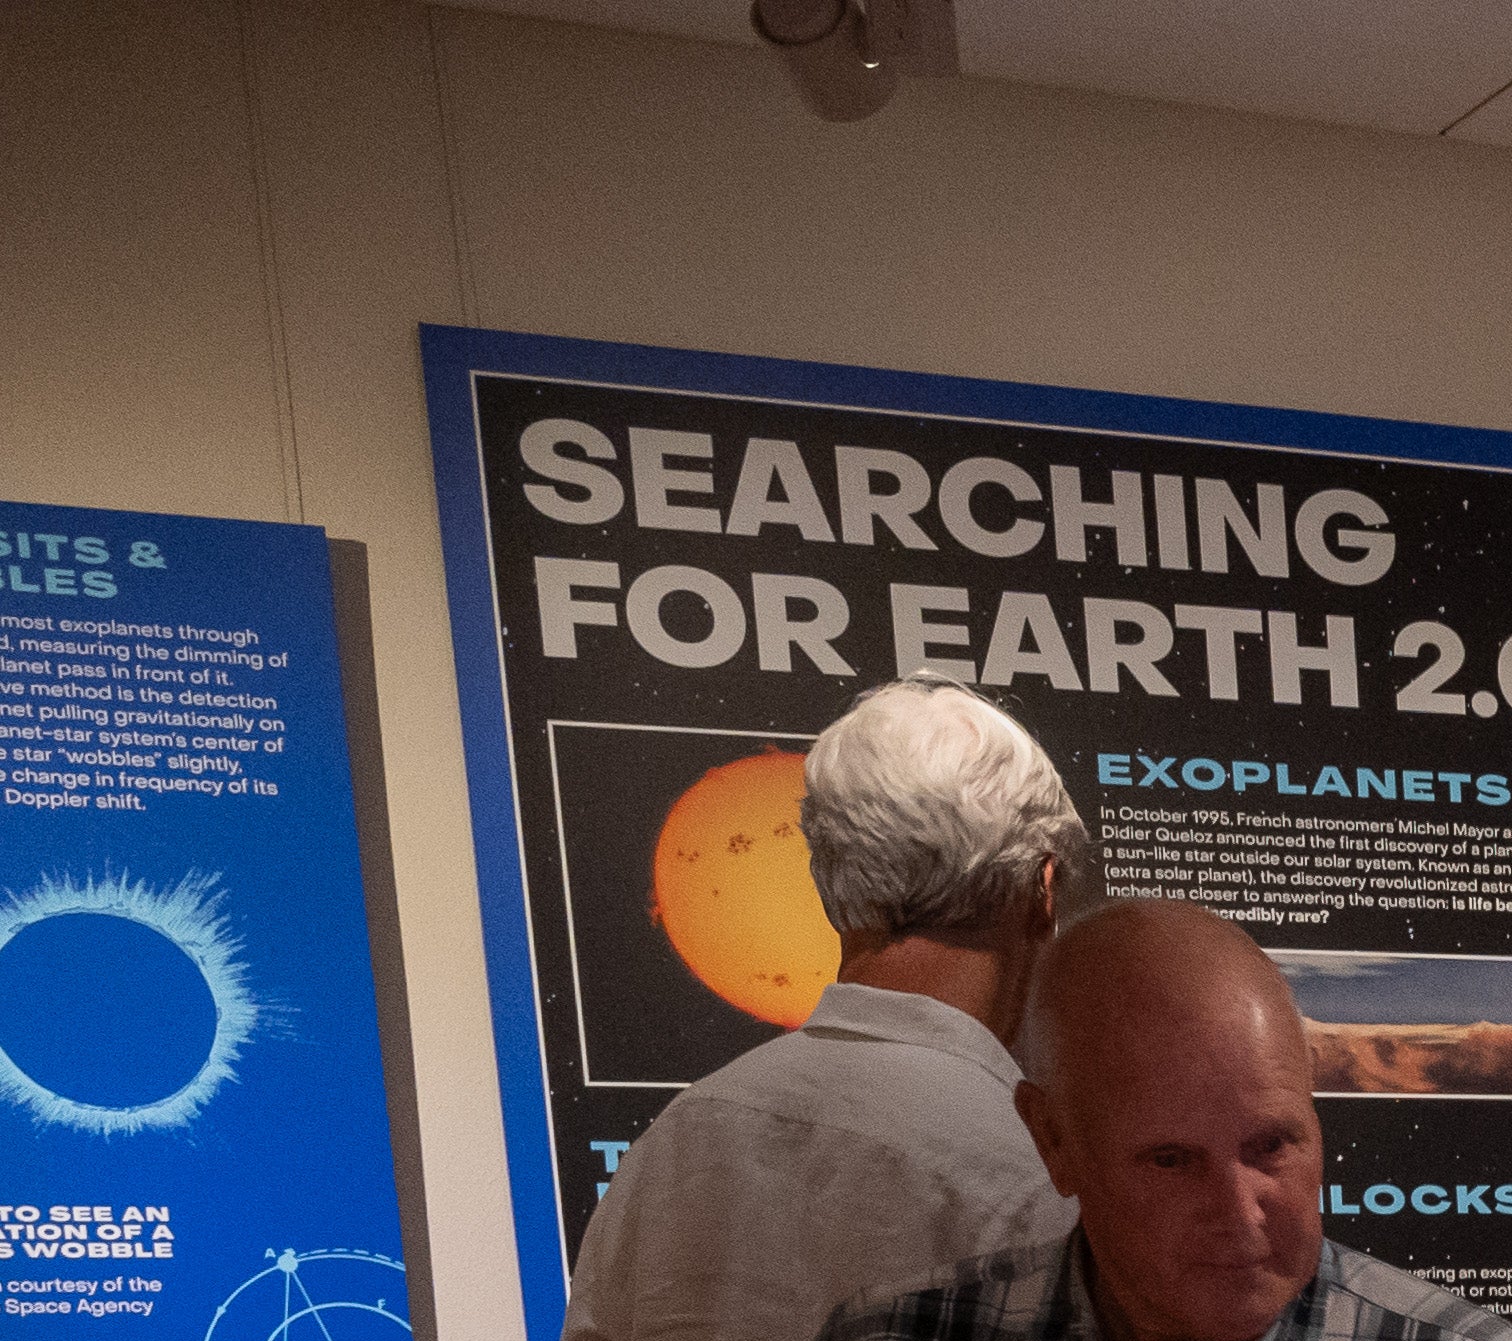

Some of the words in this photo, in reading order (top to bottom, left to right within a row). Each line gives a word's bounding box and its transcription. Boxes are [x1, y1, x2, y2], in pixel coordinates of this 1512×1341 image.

[519, 418, 1397, 588] SEARCHING
[129, 541, 167, 569] &
[0, 565, 118, 599] LES
[0, 615, 54, 631] most
[58, 619, 174, 639] exoplanets
[177, 625, 259, 647] through
[533, 556, 856, 677] FOR
[889, 584, 1360, 709] EARTH
[19, 640, 131, 661] measuring
[135, 643, 170, 660] the
[174, 646, 264, 669] dimming
[267, 652, 288, 668] of
[29, 683, 113, 700] method
[117, 686, 135, 701] is
[139, 687, 174, 704] the
[178, 690, 278, 710] detection
[38, 705, 109, 725] pulling
[113, 710, 255, 733] gravitationally
[258, 719, 286, 732] on
[12, 746, 53, 763] star
[167, 755, 243, 777] slightly.
[11, 768, 91, 789] change
[95, 772, 115, 788] in
[118, 773, 224, 796] frequency
[227, 779, 248, 794] of
[253, 780, 279, 796] its
[1097, 752, 1512, 806] EXOPLANETS
[4, 790, 90, 810] Doppler
[95, 794, 146, 811] shift.
[1099, 805, 1116, 820] In
[1118, 806, 1188, 823] October
[1236, 812, 1293, 828] French
[1295, 815, 1395, 833] astronomers
[1397, 820, 1450, 836] Michel
[1452, 822, 1500, 840] Mayor
[1101, 824, 1152, 841] Didier
[1154, 827, 1214, 843] Queloz
[1215, 832, 1306, 848] announced
[1309, 834, 1336, 849] the
[1339, 835, 1371, 851] first
[1373, 837, 1449, 857] discovery
[1451, 841, 1468, 855] of
[1471, 844, 1481, 856] a
[1103, 863, 1152, 880] (extra
[1154, 866, 1194, 881] solar
[1197, 867, 1257, 886] planet),
[1259, 870, 1287, 885] the
[1289, 871, 1367, 891] discovery
[1369, 875, 1478, 892] revolutionized
[1105, 882, 1163, 898] inched
[1165, 887, 1186, 899] us
[1188, 886, 1239, 901] closer
[1242, 887, 1261, 902] to
[1263, 891, 1346, 908] answering
[1348, 892, 1375, 907] the
[1451, 896, 1466, 910] is
[1468, 896, 1493, 911] life
[1207, 906, 1285, 925] credibly
[1288, 909, 1330, 924] rare?
[0, 1205, 40, 1222] TO
[50, 1206, 113, 1222] SEE
[122, 1206, 170, 1222] AN
[96, 1224, 142, 1240] OF
[152, 1224, 175, 1240] A
[22, 1242, 174, 1258] WOBBLE
[7, 1278, 98, 1296] courtesy
[103, 1276, 123, 1292] of
[129, 1276, 163, 1292] the
[5, 1298, 71, 1316] Space
[77, 1298, 153, 1317] Agency
